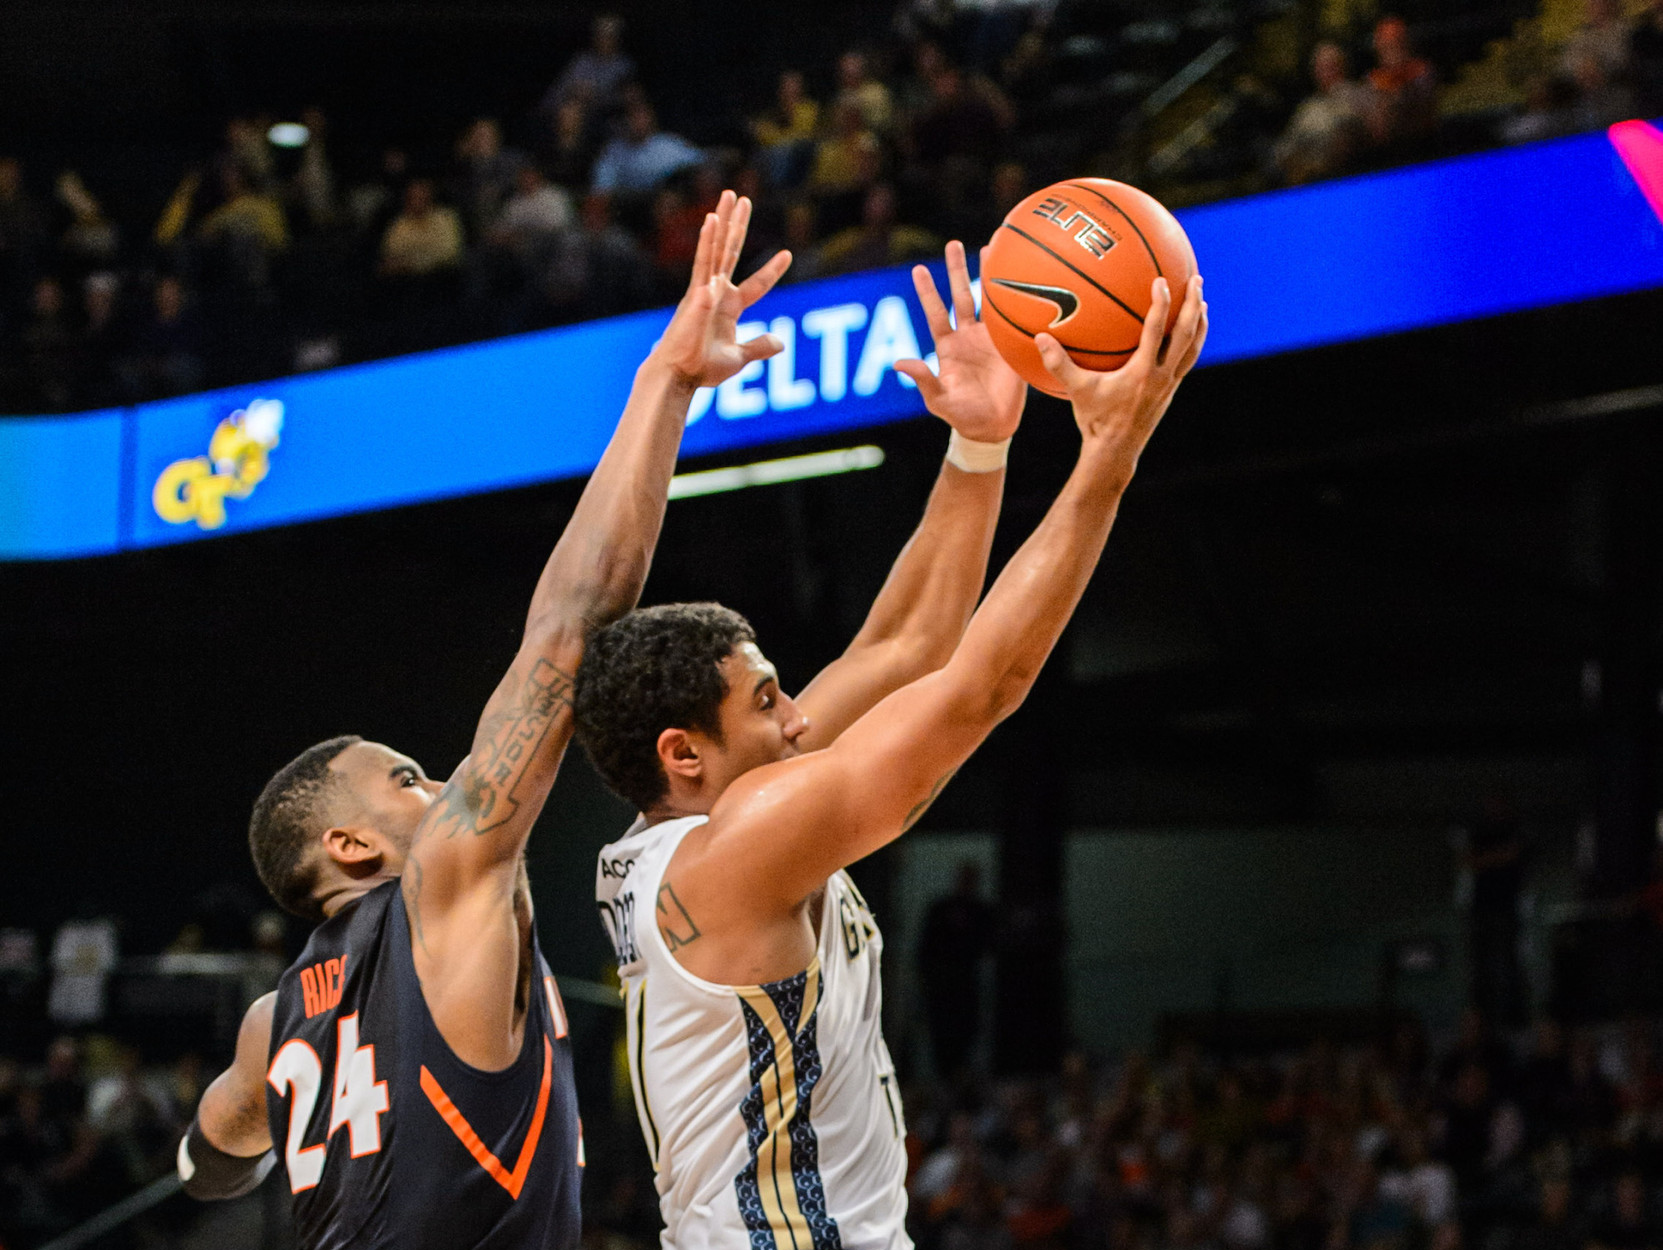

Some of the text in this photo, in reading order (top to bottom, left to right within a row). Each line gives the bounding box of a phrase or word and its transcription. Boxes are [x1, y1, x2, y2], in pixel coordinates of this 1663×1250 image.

[1032, 197, 1118, 260] ELITE
[686, 296, 922, 427] ELTA
[266, 1009, 391, 1196] 24
